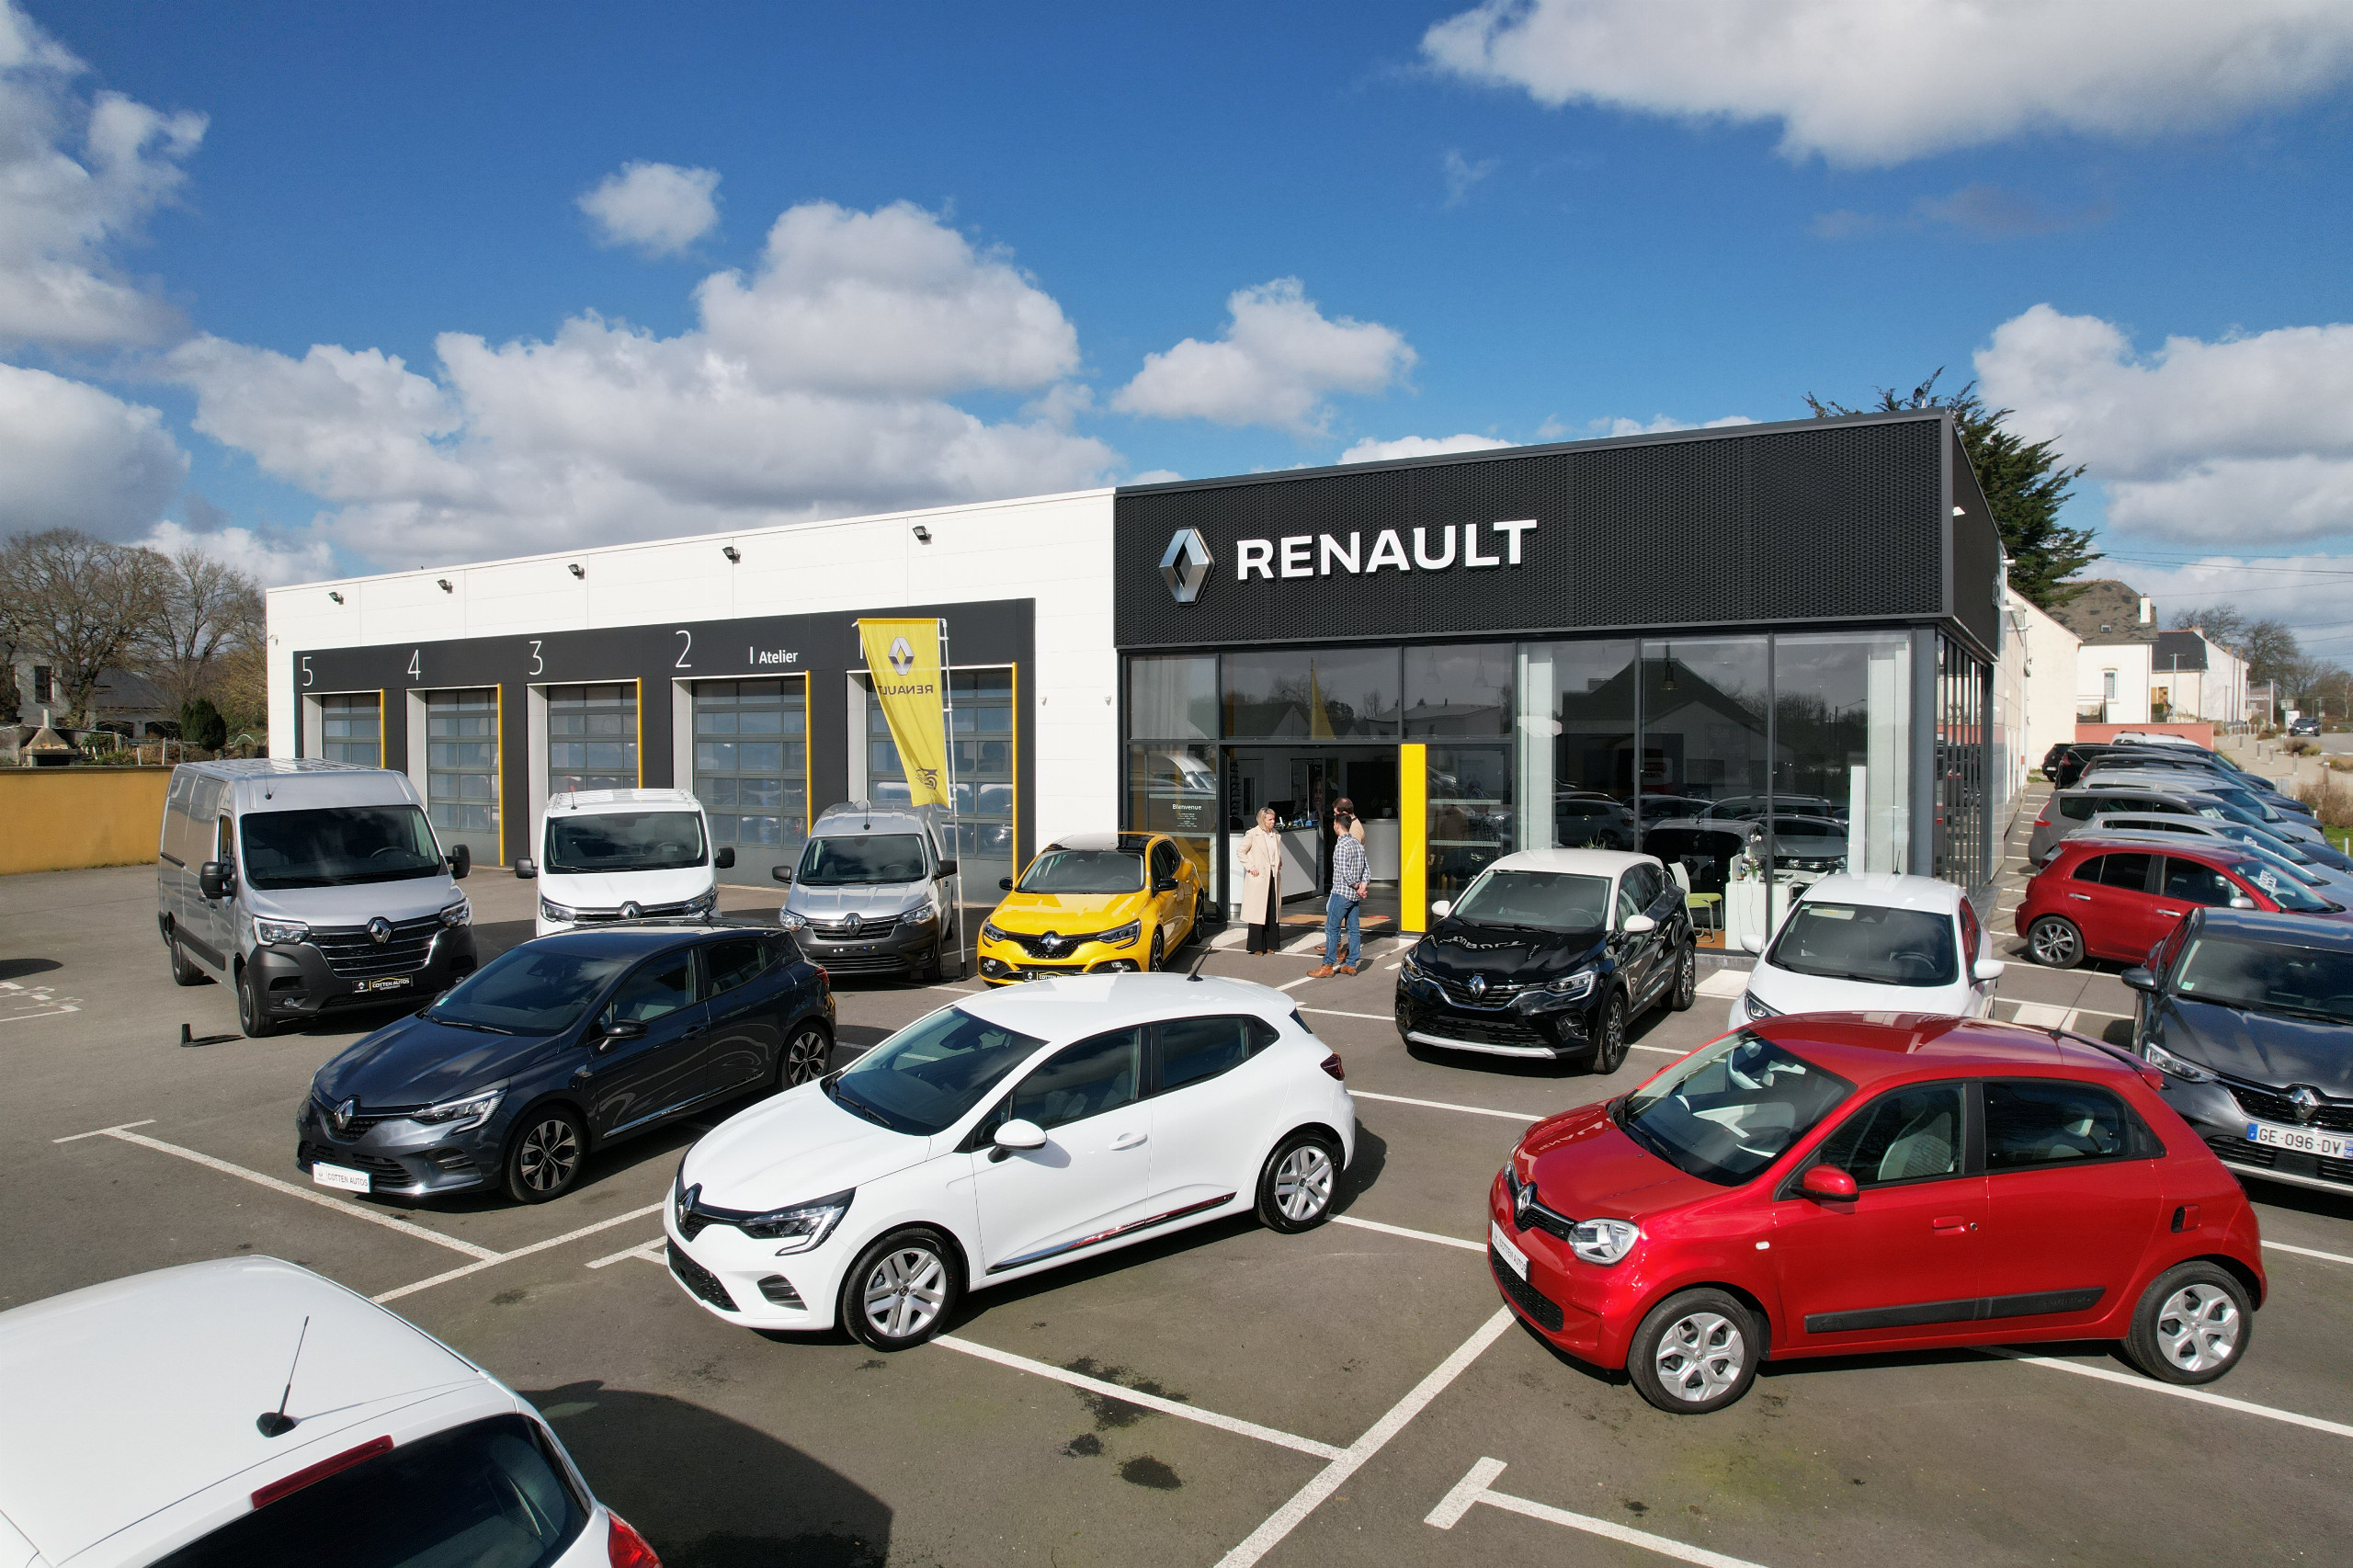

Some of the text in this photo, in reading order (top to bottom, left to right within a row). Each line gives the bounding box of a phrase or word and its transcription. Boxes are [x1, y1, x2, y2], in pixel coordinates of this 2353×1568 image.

[1236, 519, 1538, 580] RENAULT
[407, 649, 421, 680] 4
[529, 640, 543, 676] 3
[675, 630, 692, 668] 2
[758, 650, 799, 665] Atelier
[302, 656, 313, 687] 5
[327, 1172, 348, 1183] COTTEN
[349, 1176, 369, 1187] AUTOS
